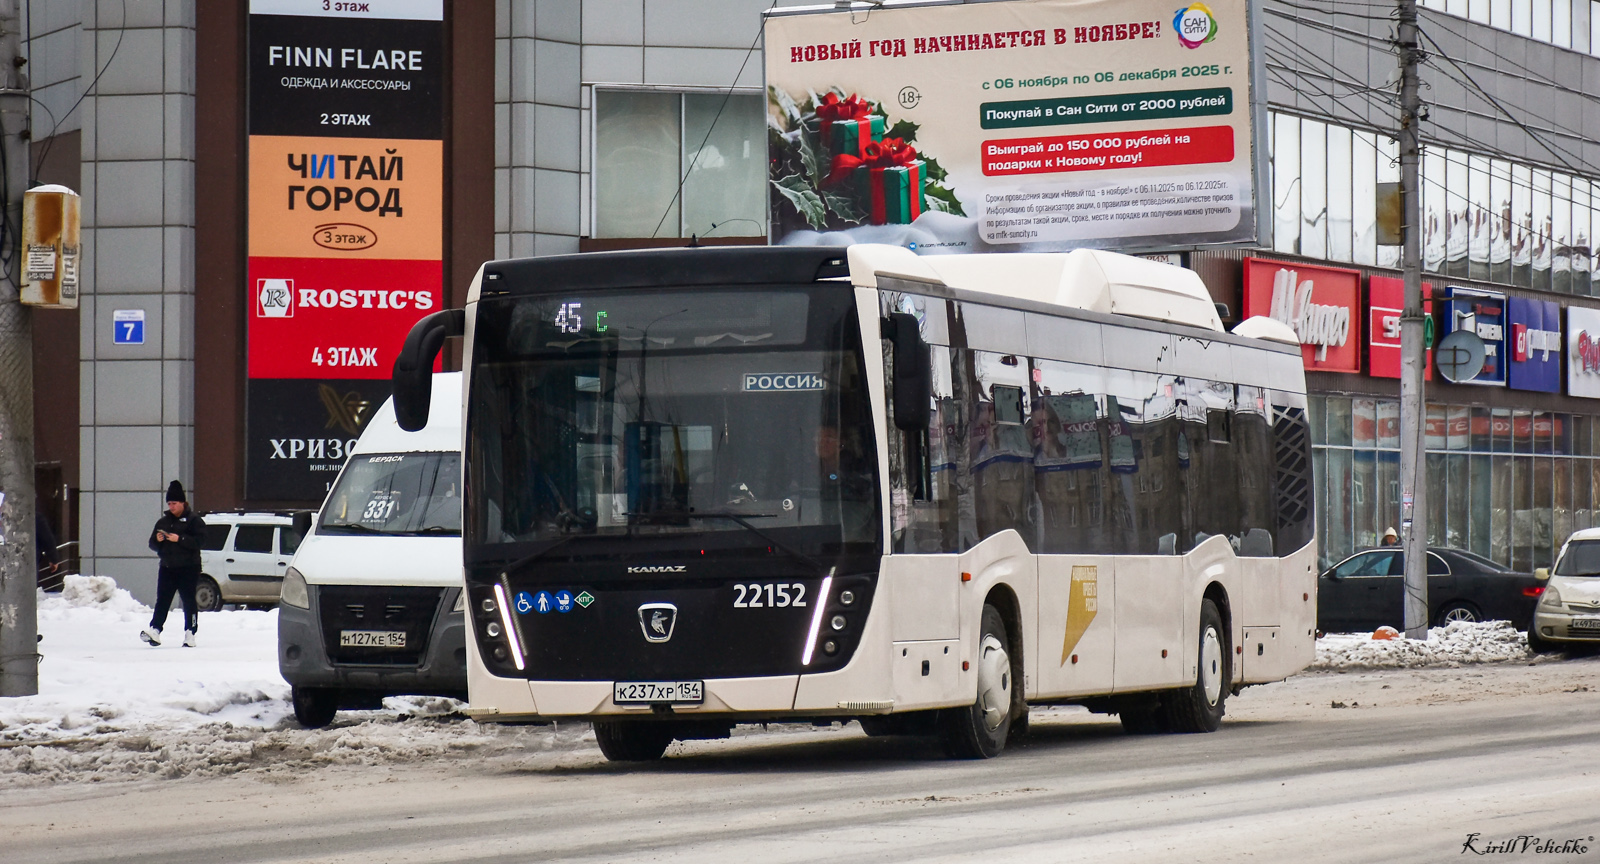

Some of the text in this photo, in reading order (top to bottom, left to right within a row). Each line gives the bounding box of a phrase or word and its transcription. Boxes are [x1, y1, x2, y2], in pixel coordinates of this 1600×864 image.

[323, 0, 369, 12] 3 этаж
[1184, 17, 1206, 27] САН
[791, 21, 1160, 62] НОВЫЙ ГОД НАЧИНАЕТСЯ В НОЯБРЕ!
[269, 46, 422, 71] FINN FLARE
[281, 77, 410, 91] ОДЕЖДА И АКСЕССУАРЫ
[982, 65, 1232, 89] с 06 ноября по 06 декабря 2025 г.
[902, 92, 922, 104] 18+
[986, 106, 1041, 121] Покупай
[1057, 105, 1081, 116] Сан
[1085, 102, 1117, 114] Сити
[1122, 102, 1135, 112] от
[1140, 99, 1176, 110] 2000
[1180, 95, 1225, 109] рублей
[320, 114, 370, 126] 2 ЭТАЖ
[988, 134, 1190, 156] Выиграй до 150 000 рублей на
[288, 148, 403, 180] ЧИТАЙ
[988, 152, 1142, 172] подарки к Новому году!
[288, 186, 402, 217] ГОРОД
[986, 194, 1004, 202] Сроки
[1005, 192, 1040, 202] проведения
[1042, 191, 1059, 200] акции
[1061, 189, 1084, 198] «Новый
[1140, 183, 1175, 194] 06.11.2025
[986, 206, 1025, 215] Информацию
[1027, 204, 1034, 212] об
[1036, 202, 1074, 212] организаторе
[1102, 200, 1130, 209] правилах
[1212, 194, 1233, 202] призов
[995, 218, 1031, 228] результатам
[1033, 216, 1050, 224] такой
[1116, 211, 1140, 221] порядке
[1142, 210, 1148, 218] их
[1150, 208, 1182, 218] получения
[1205, 206, 1231, 216] уточнить
[324, 232, 367, 244] 3 этаж
[299, 289, 432, 309] ROSTIC'S
[555, 304, 581, 333] 45
[124, 323, 134, 340] 7
[312, 347, 377, 366] 4 ЭТАЖ
[746, 375, 822, 389] РОССИЯ
[364, 500, 395, 519] 331
[734, 583, 806, 607] 22152
[344, 633, 403, 645] Н127КЕ 154
[620, 684, 698, 698] К237ХР 154
